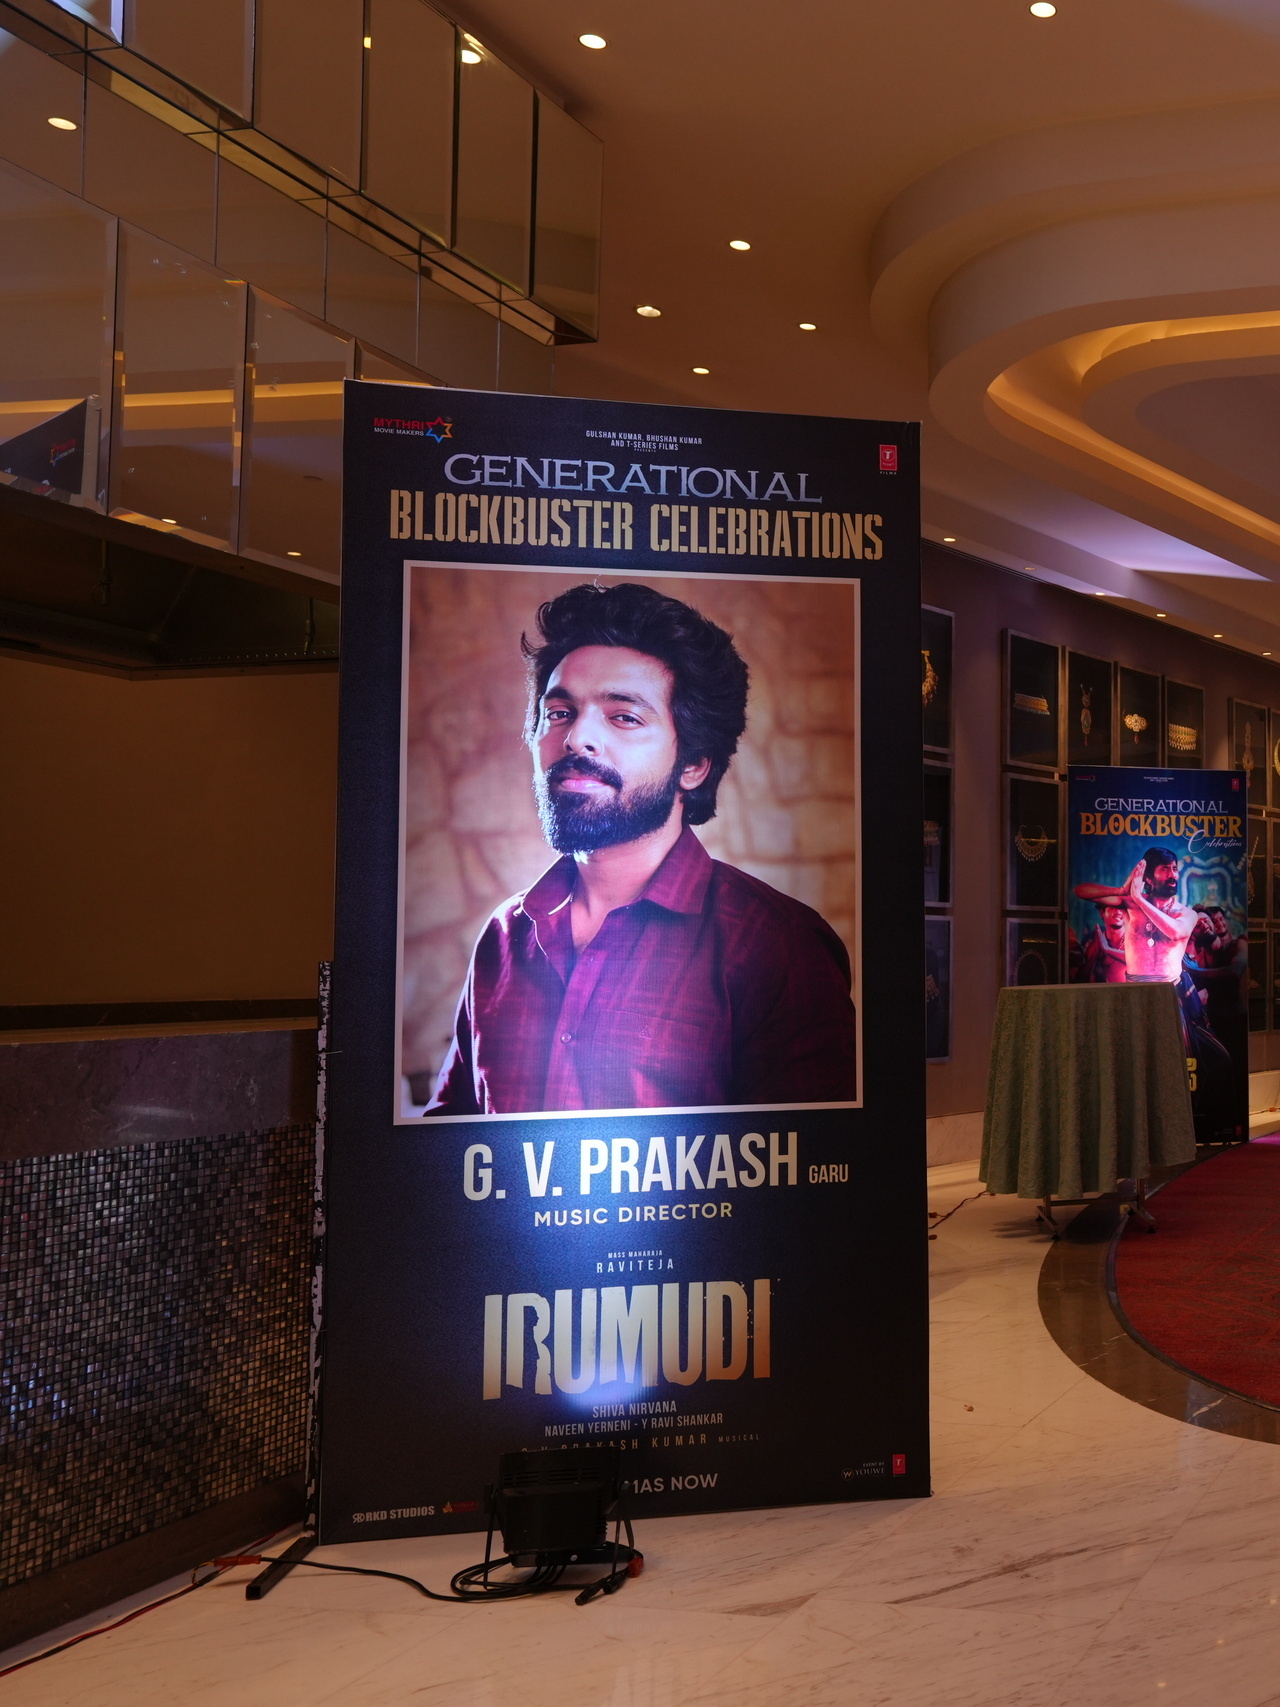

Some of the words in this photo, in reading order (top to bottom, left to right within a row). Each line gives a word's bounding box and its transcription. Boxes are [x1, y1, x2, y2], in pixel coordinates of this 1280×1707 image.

[373, 417, 424, 430] MYTHRI
[396, 429, 424, 437] MAKERS
[585, 430, 617, 439] GULSHAN
[646, 434, 678, 443] BHUSHAN
[680, 436, 703, 445] KUMAR
[627, 440, 657, 450] T-SERIES
[659, 443, 679, 451] FILMS
[444, 453, 823, 503] GENERATIONAL
[390, 489, 633, 550] BLOCKBUSTER
[650, 503, 883, 561] CELEBRATIONS
[1094, 797, 1228, 814] GENERATIONAL
[1079, 812, 1242, 838] BLOCKBUSTER
[464, 1143, 506, 1200] G.
[522, 1141, 562, 1197] V.
[580, 1131, 798, 1195] PRAKASH
[808, 1163, 849, 1184] GARU
[534, 1207, 609, 1228] MUSIC
[618, 1202, 734, 1224] DIRECTOR
[628, 1250, 663, 1258] MAHARAJA
[596, 1259, 674, 1273] RAVITEJA
[483, 1279, 773, 1400] IRUMUDI
[592, 1404, 625, 1418] SHIVA
[629, 1401, 677, 1416] NIRVANA
[545, 1424, 584, 1437] NAVEEN
[588, 1420, 631, 1433] YERNENI
[641, 1419, 648, 1430] Y
[651, 1416, 674, 1428] RAVI
[677, 1413, 723, 1427] SHANKAR
[652, 1434, 707, 1448] KUMAR
[718, 1434, 760, 1442] MUSICAL
[671, 1473, 718, 1491] NOW
[366, 1511, 387, 1522] RKD
[390, 1506, 435, 1519] STUDIOS
